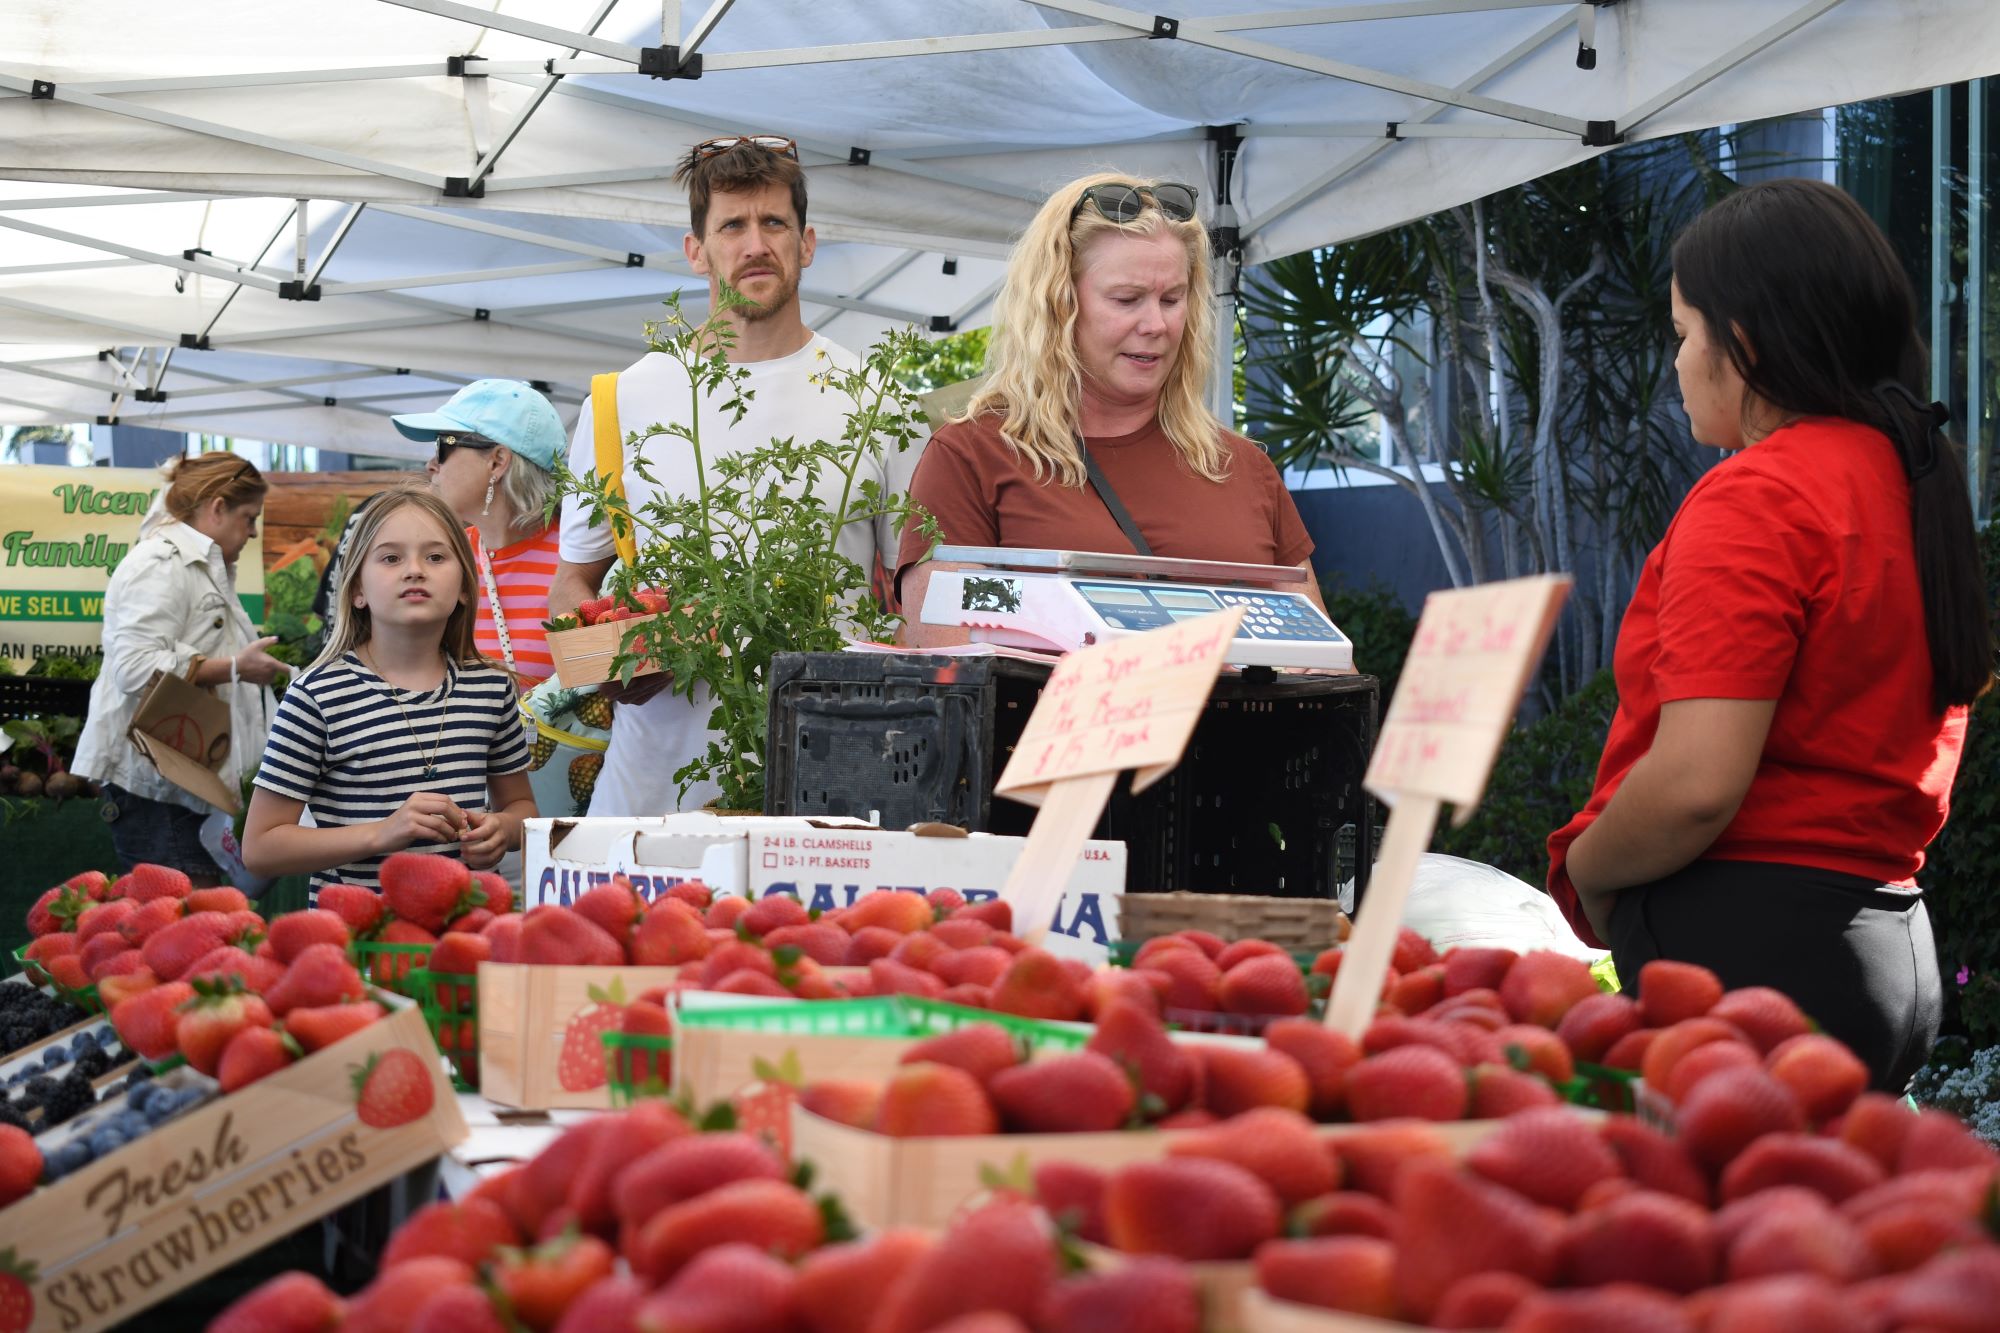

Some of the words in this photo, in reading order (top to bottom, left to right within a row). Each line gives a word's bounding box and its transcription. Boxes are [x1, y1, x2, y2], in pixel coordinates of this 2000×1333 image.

[2, 531, 129, 577] Family
[27, 596, 74, 616] SELL
[802, 838, 873, 851] CLAMSHELLS
[825, 857, 871, 869] BASKETS
[85, 1110, 247, 1238] Fresh
[45, 1131, 368, 1331] Strawberries
